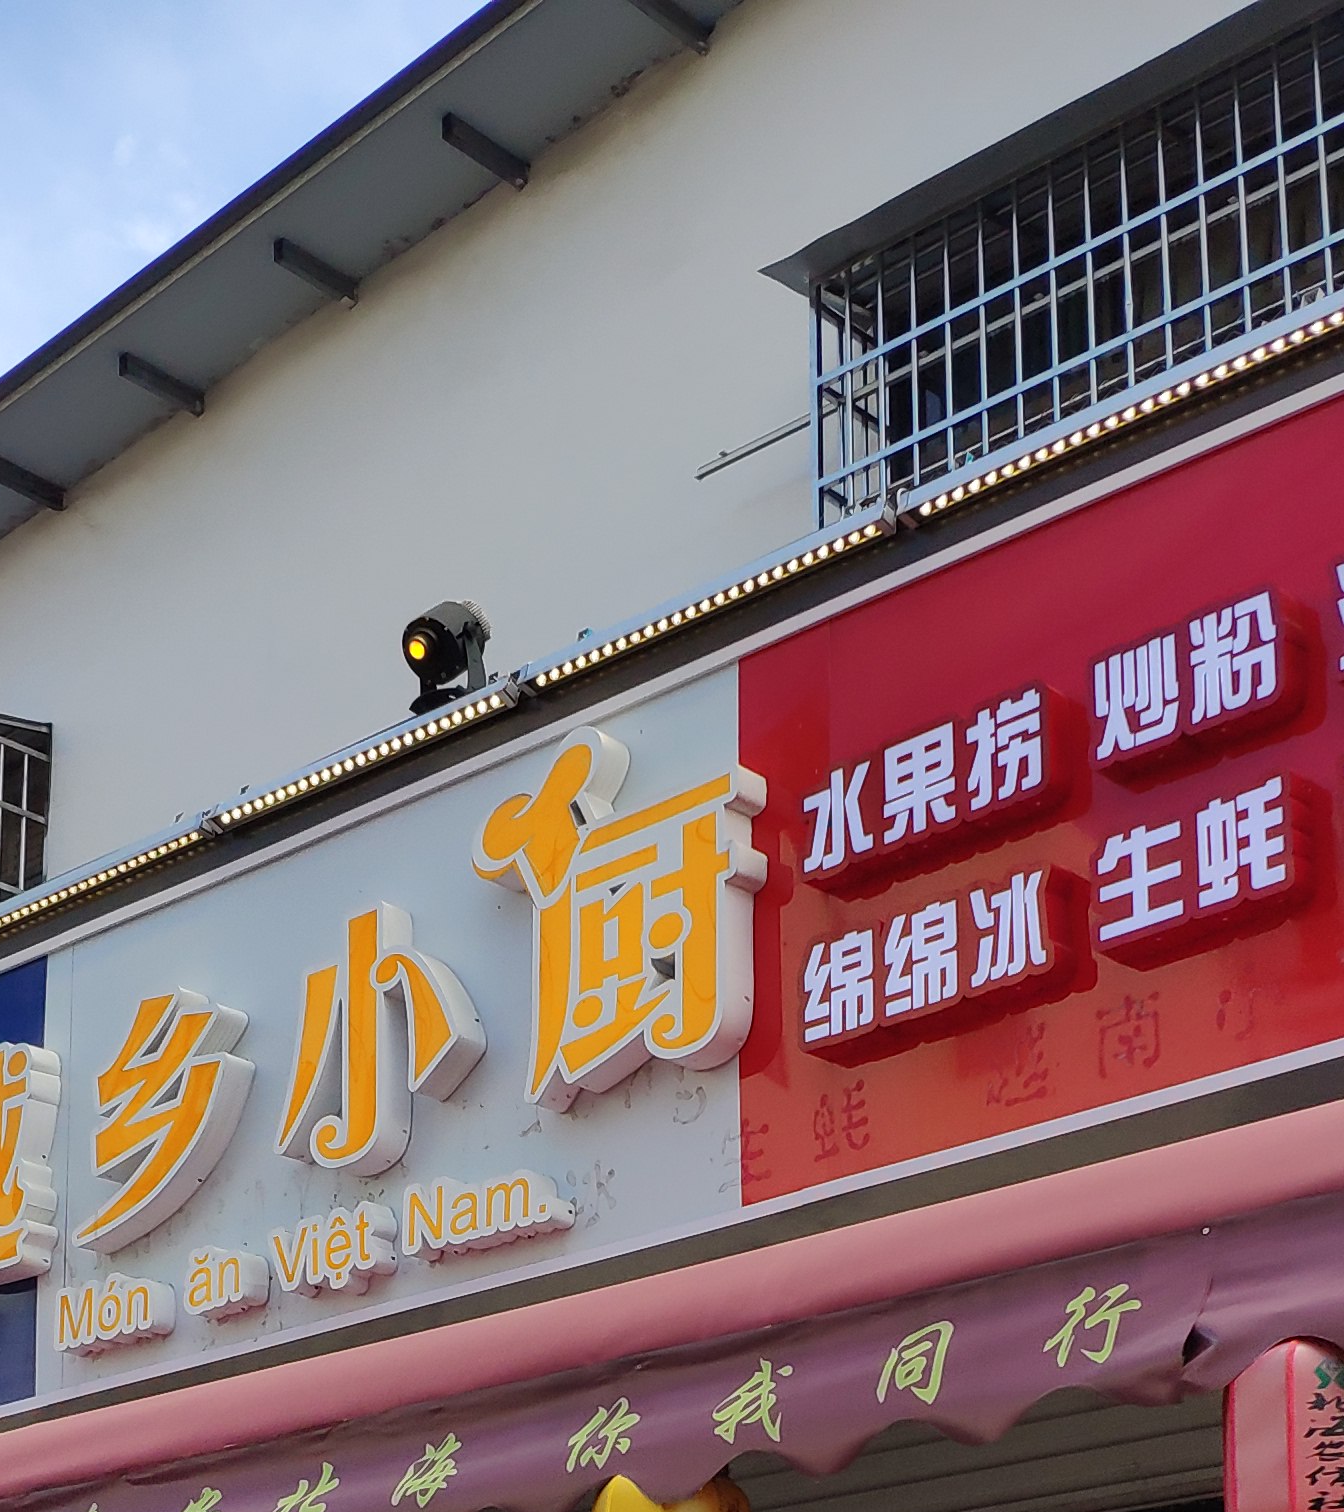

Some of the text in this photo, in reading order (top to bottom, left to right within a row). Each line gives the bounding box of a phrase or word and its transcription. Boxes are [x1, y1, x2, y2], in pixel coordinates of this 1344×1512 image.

[802, 688, 1044, 875] 水果捞
[1093, 593, 1277, 762] 炒粉
[802, 870, 1048, 1045] 绵绵冰
[1097, 776, 1286, 943] 生蚝
[59, 1285, 150, 1347] Món
[188, 1251, 242, 1306] ăn
[271, 1215, 372, 1291] Việt
[565, 1282, 1144, 1473] 你我同行
